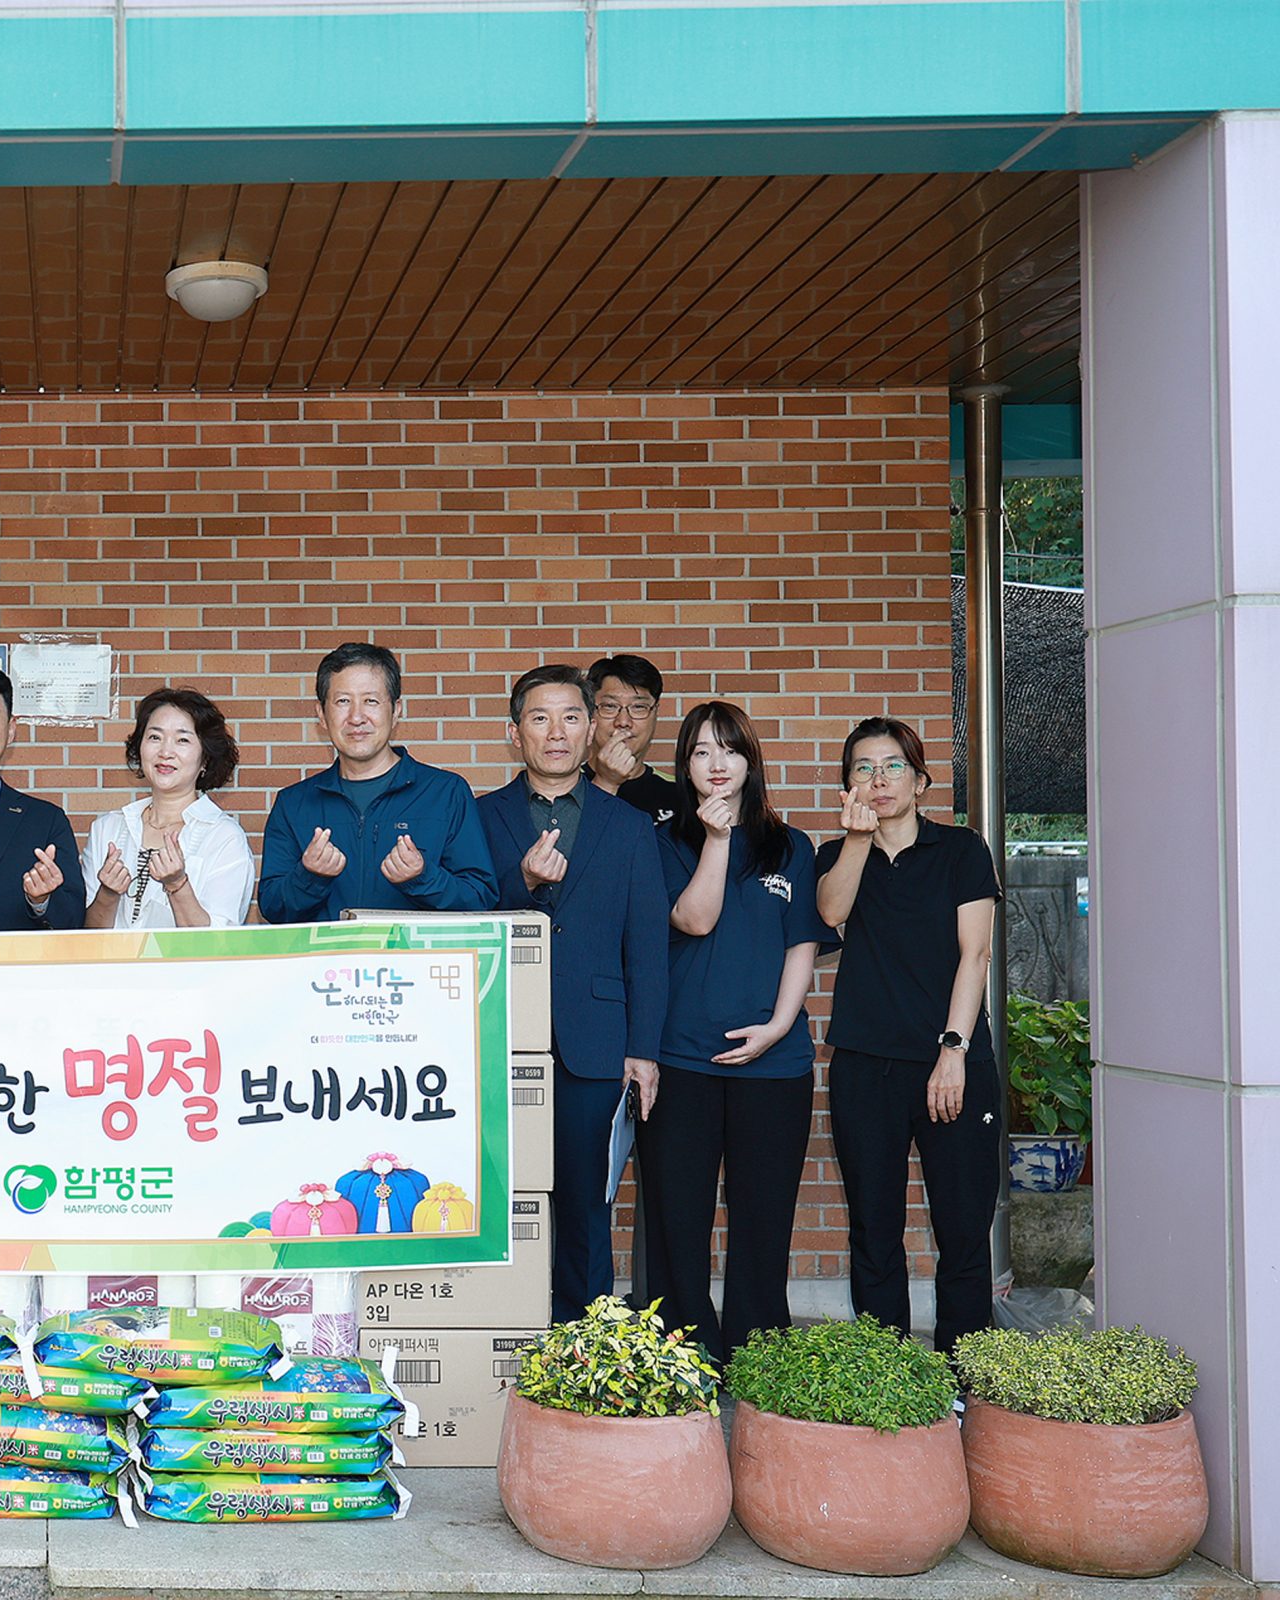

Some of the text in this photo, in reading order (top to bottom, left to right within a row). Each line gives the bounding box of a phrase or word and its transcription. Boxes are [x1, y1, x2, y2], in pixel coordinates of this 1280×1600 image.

[344, 994, 388, 1009] 하나되는
[352, 1009, 399, 1025] 대한민국
[310, 1035, 319, 1044] 더
[320, 1034, 344, 1043] 따뜻한
[63, 1028, 222, 1142] 명절
[238, 1064, 456, 1125] 보내세요
[63, 1166, 173, 1201] 함평군
[64, 1203, 173, 1214] HAMPYEONG COUNTY
[366, 1283, 454, 1299] AP 다온 1호
[366, 1305, 389, 1322] 3입
[434, 1421, 458, 1437] 1호
